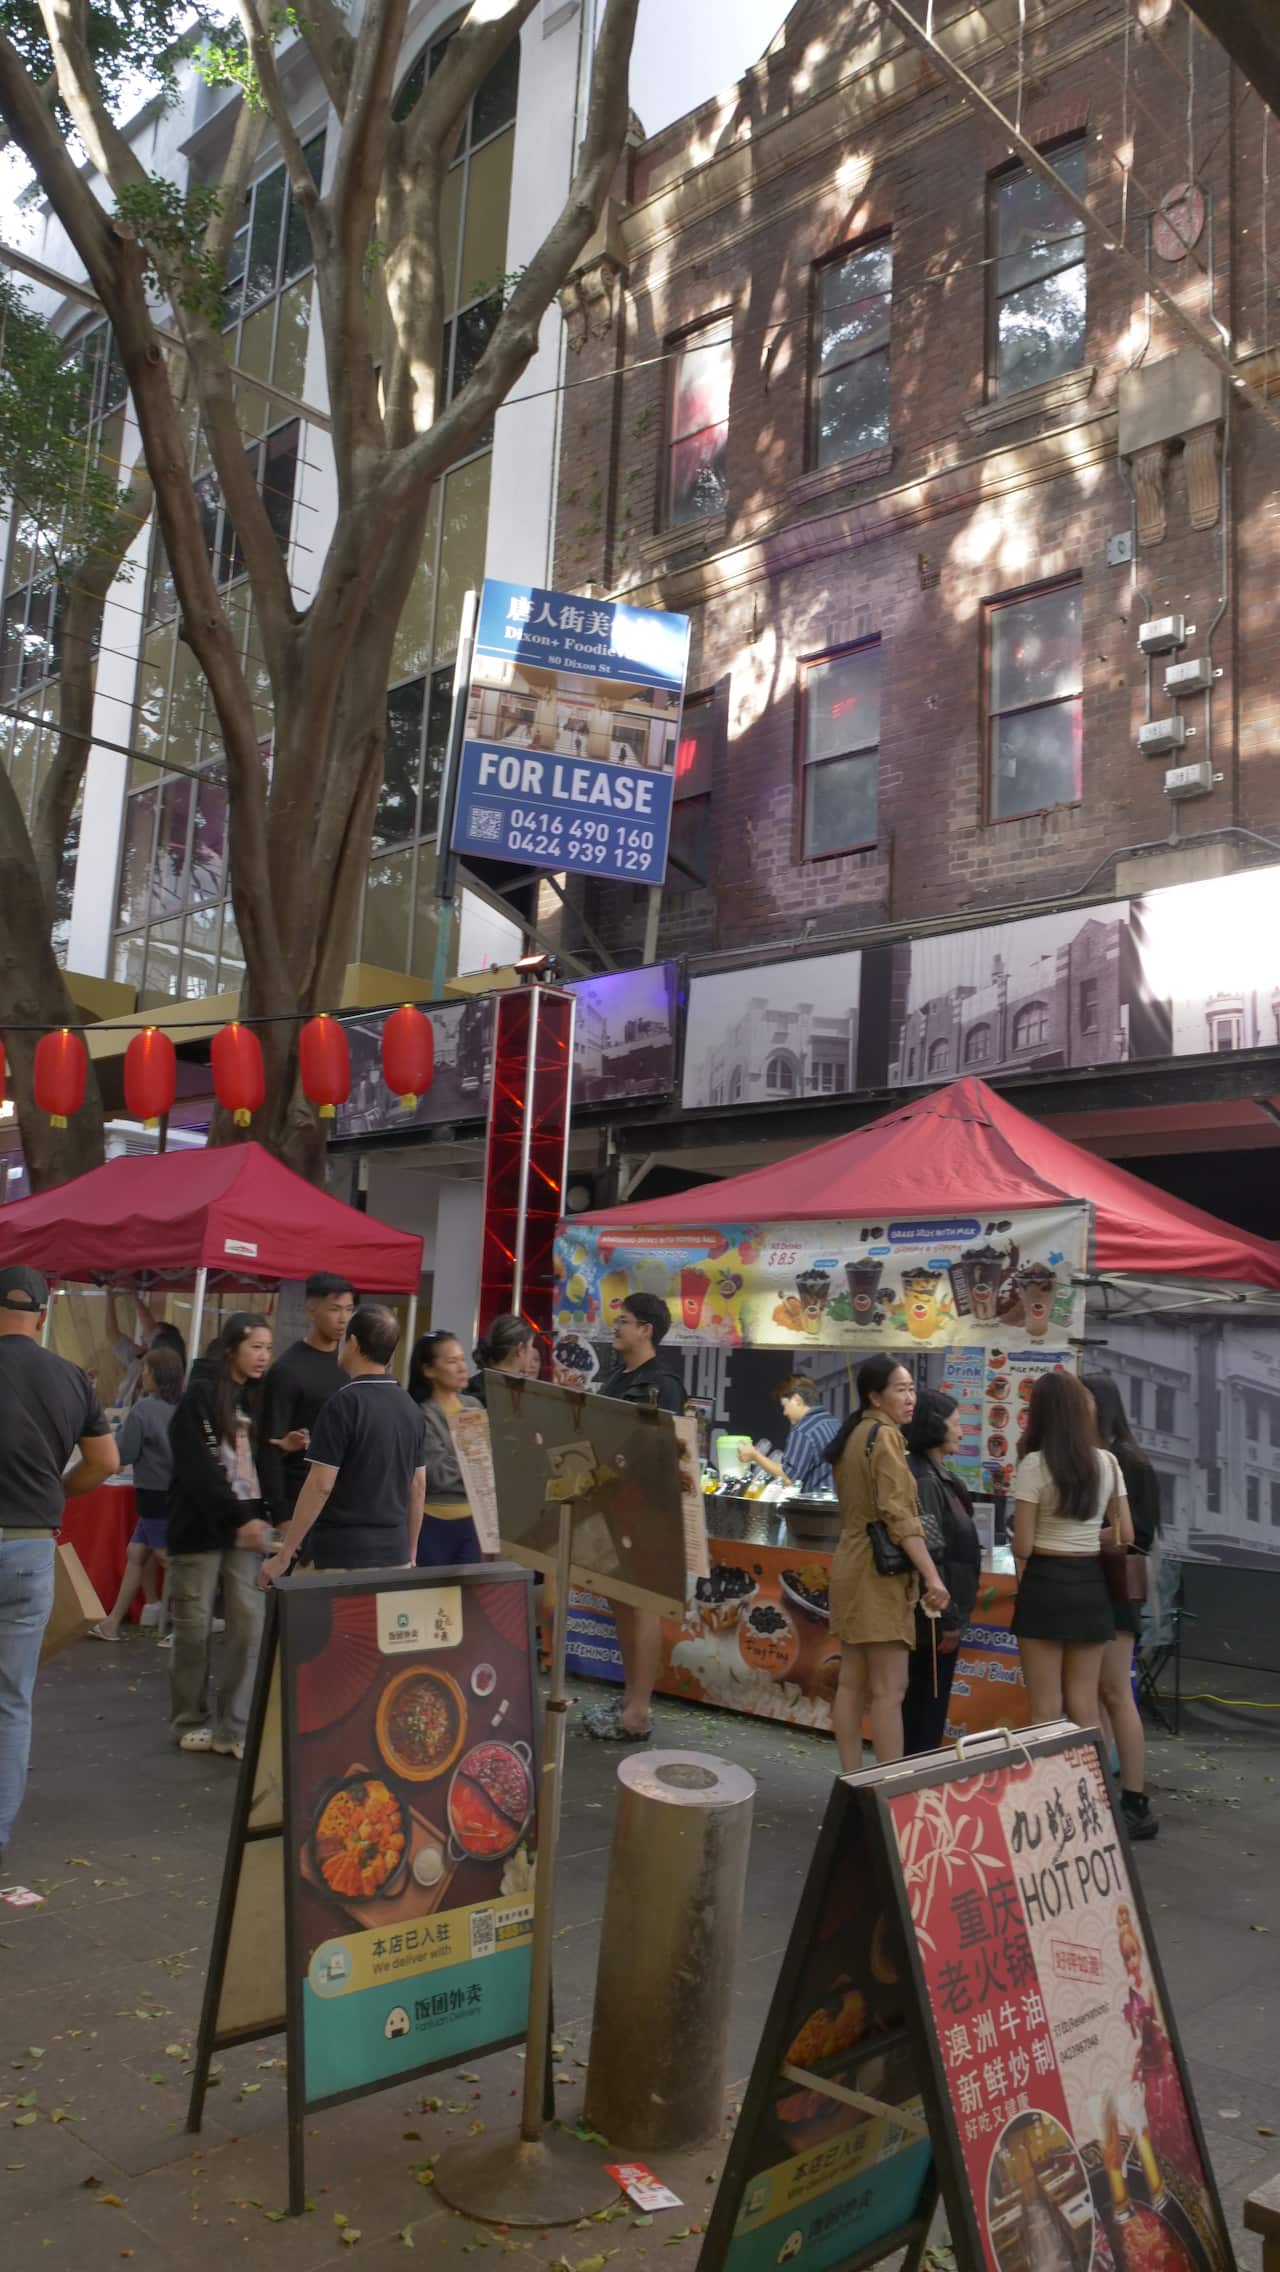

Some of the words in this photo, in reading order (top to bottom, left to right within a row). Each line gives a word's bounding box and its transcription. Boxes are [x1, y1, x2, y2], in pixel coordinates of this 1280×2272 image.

[504, 625, 560, 648] Dixon+
[563, 657, 596, 673] Dixon
[598, 664, 612, 674] St
[478, 752, 544, 794] FOR
[552, 764, 655, 815] LEASE
[511, 809, 562, 836] 0416
[569, 819, 610, 843] 490
[617, 826, 654, 850] 160
[508, 831, 561, 858] 0424
[567, 841, 607, 864] 939
[614, 848, 652, 872] 129
[681, 1346, 733, 1422] THE
[945, 1364, 981, 1377] Drink
[1019, 1860, 1075, 1927] HOT
[1075, 1843, 1123, 1904] POT
[950, 1876, 1025, 1950] 重庆
[372, 1922, 450, 1958] 本店已入驻
[372, 1961, 391, 1976] We
[391, 1952, 428, 1970] deliver
[430, 1945, 452, 1961] with
[937, 1932, 1039, 2016] 老火锅
[414, 1983, 483, 2021] 饭团外卖
[944, 1989, 1046, 2068] 澳洲牛油
[956, 2034, 1056, 2115] 新鲜炒制
